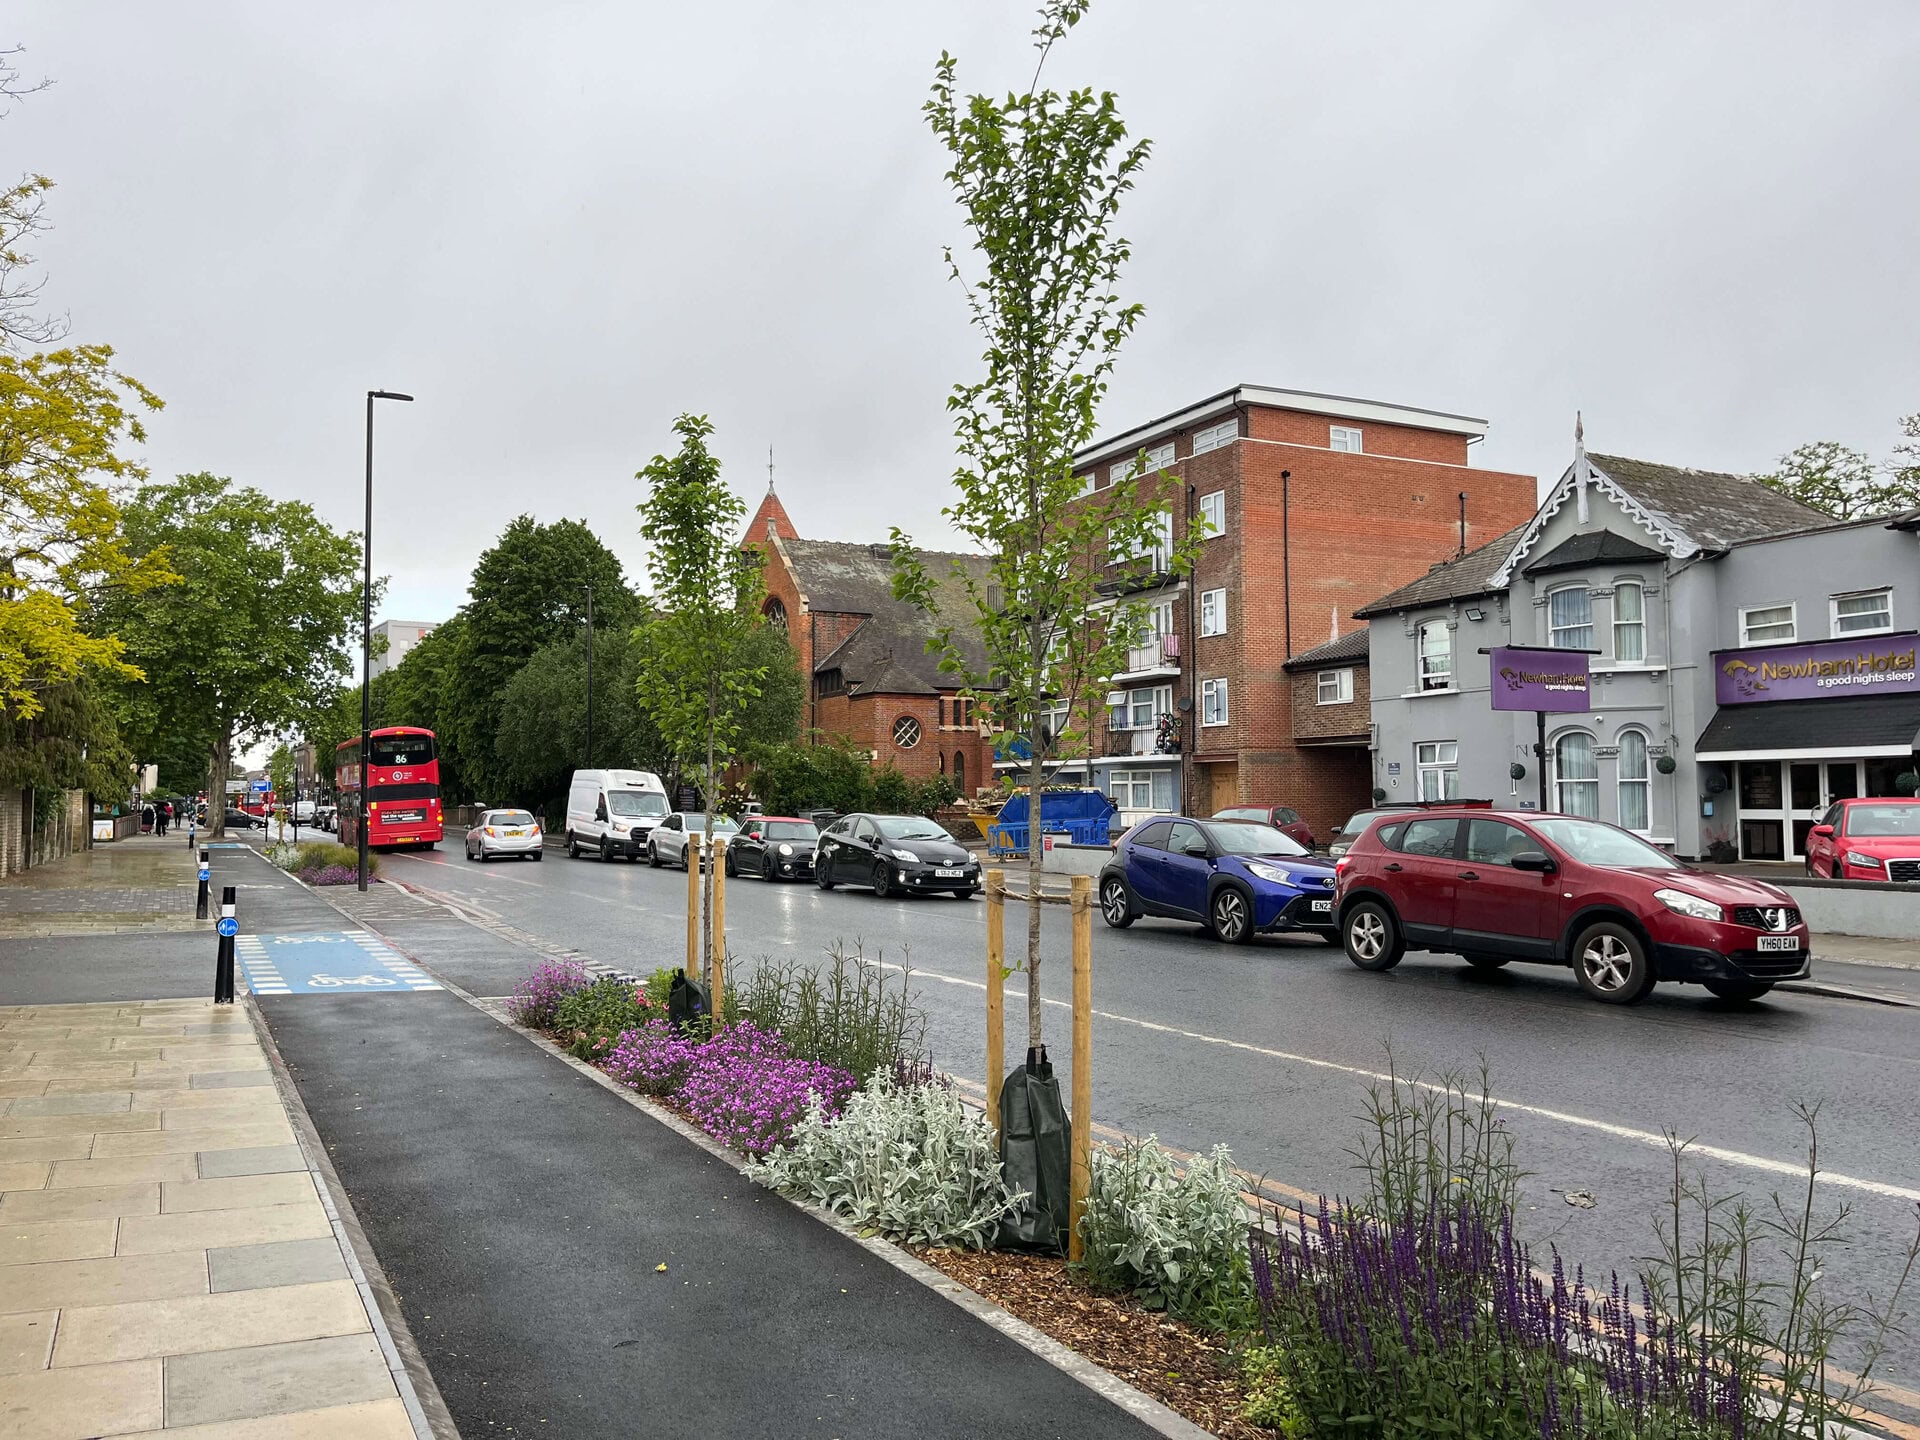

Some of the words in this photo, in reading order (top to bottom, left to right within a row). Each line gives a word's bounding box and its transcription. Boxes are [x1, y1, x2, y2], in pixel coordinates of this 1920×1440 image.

[1761, 657, 1854, 681] Newham
[1857, 648, 1915, 673] Hotel
[1519, 671, 1560, 684] Newham
[1561, 673, 1586, 685] Hotel
[1817, 678, 1824, 686] a
[1825, 675, 1852, 688] good
[1853, 673, 1884, 686] nights
[1886, 671, 1915, 682] sleep
[395, 754, 407, 764] 86
[1761, 938, 1782, 949] YH60
[1783, 937, 1797, 949] EAW
